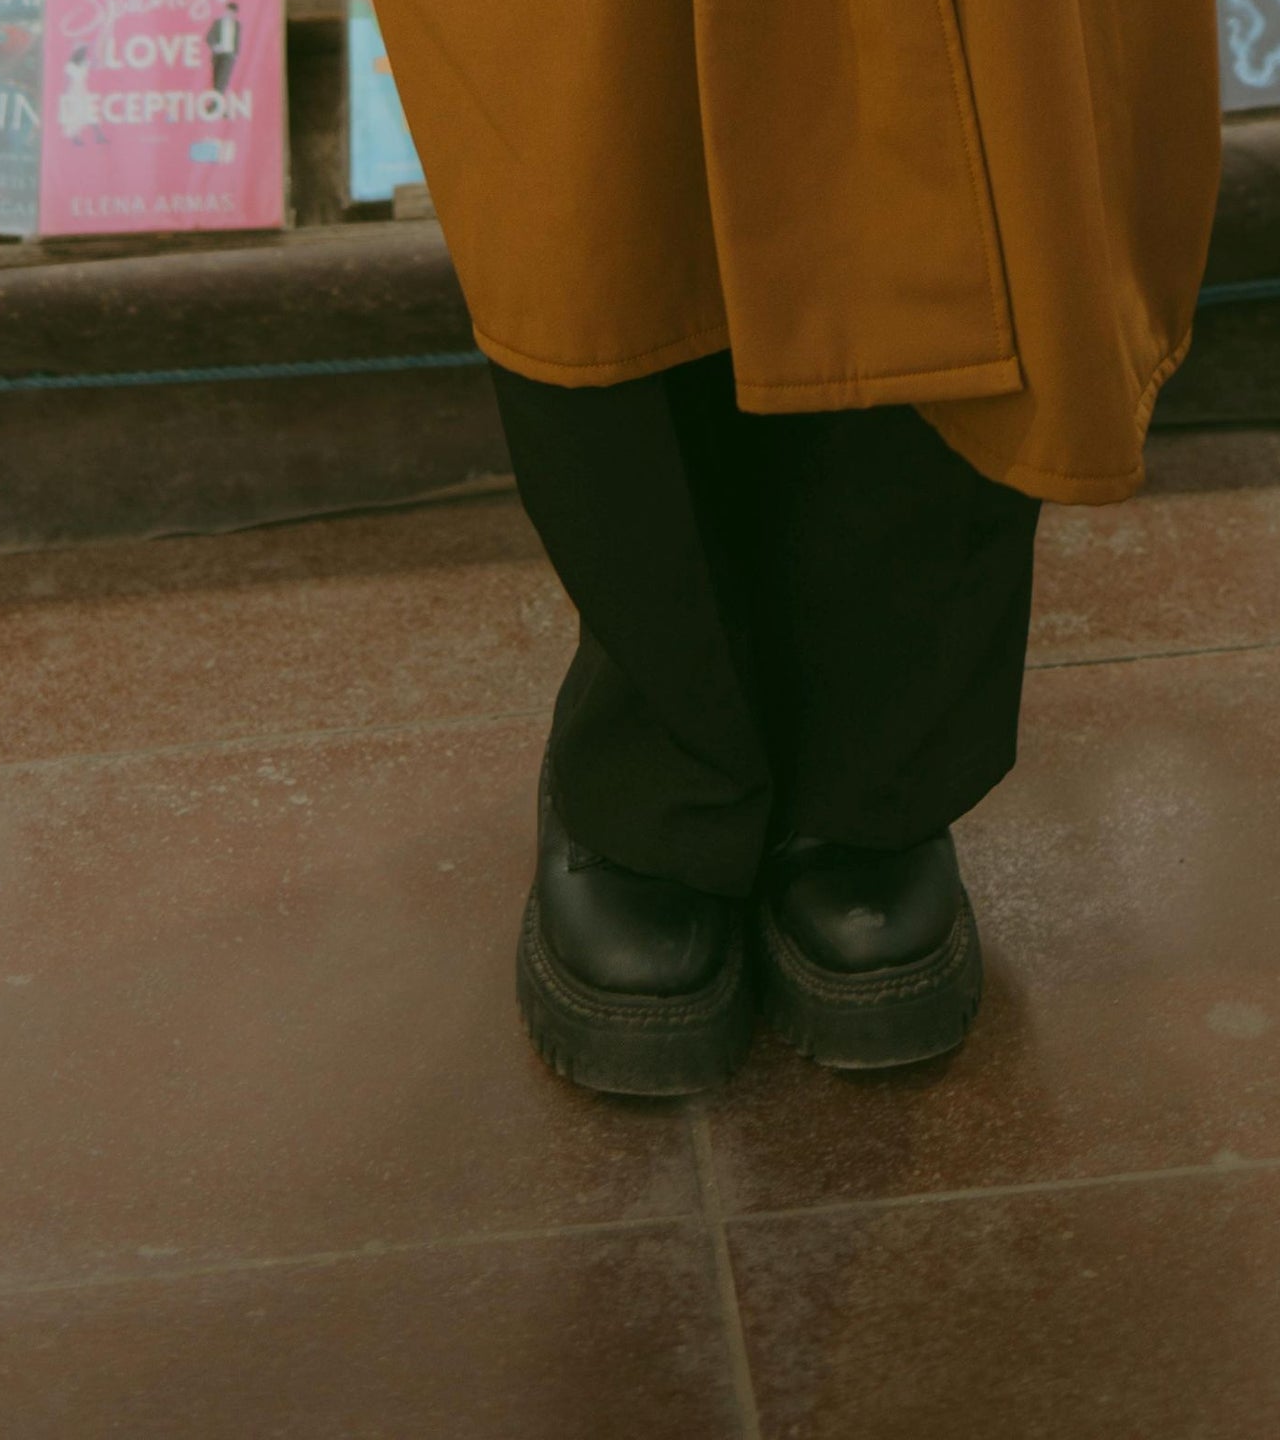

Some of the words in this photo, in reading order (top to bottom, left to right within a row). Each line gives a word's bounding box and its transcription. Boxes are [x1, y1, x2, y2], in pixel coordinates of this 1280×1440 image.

[105, 32, 204, 71] LOVE
[56, 88, 254, 127] DECEPTION
[70, 194, 147, 219] ELENA
[154, 191, 237, 213] ARMAS
